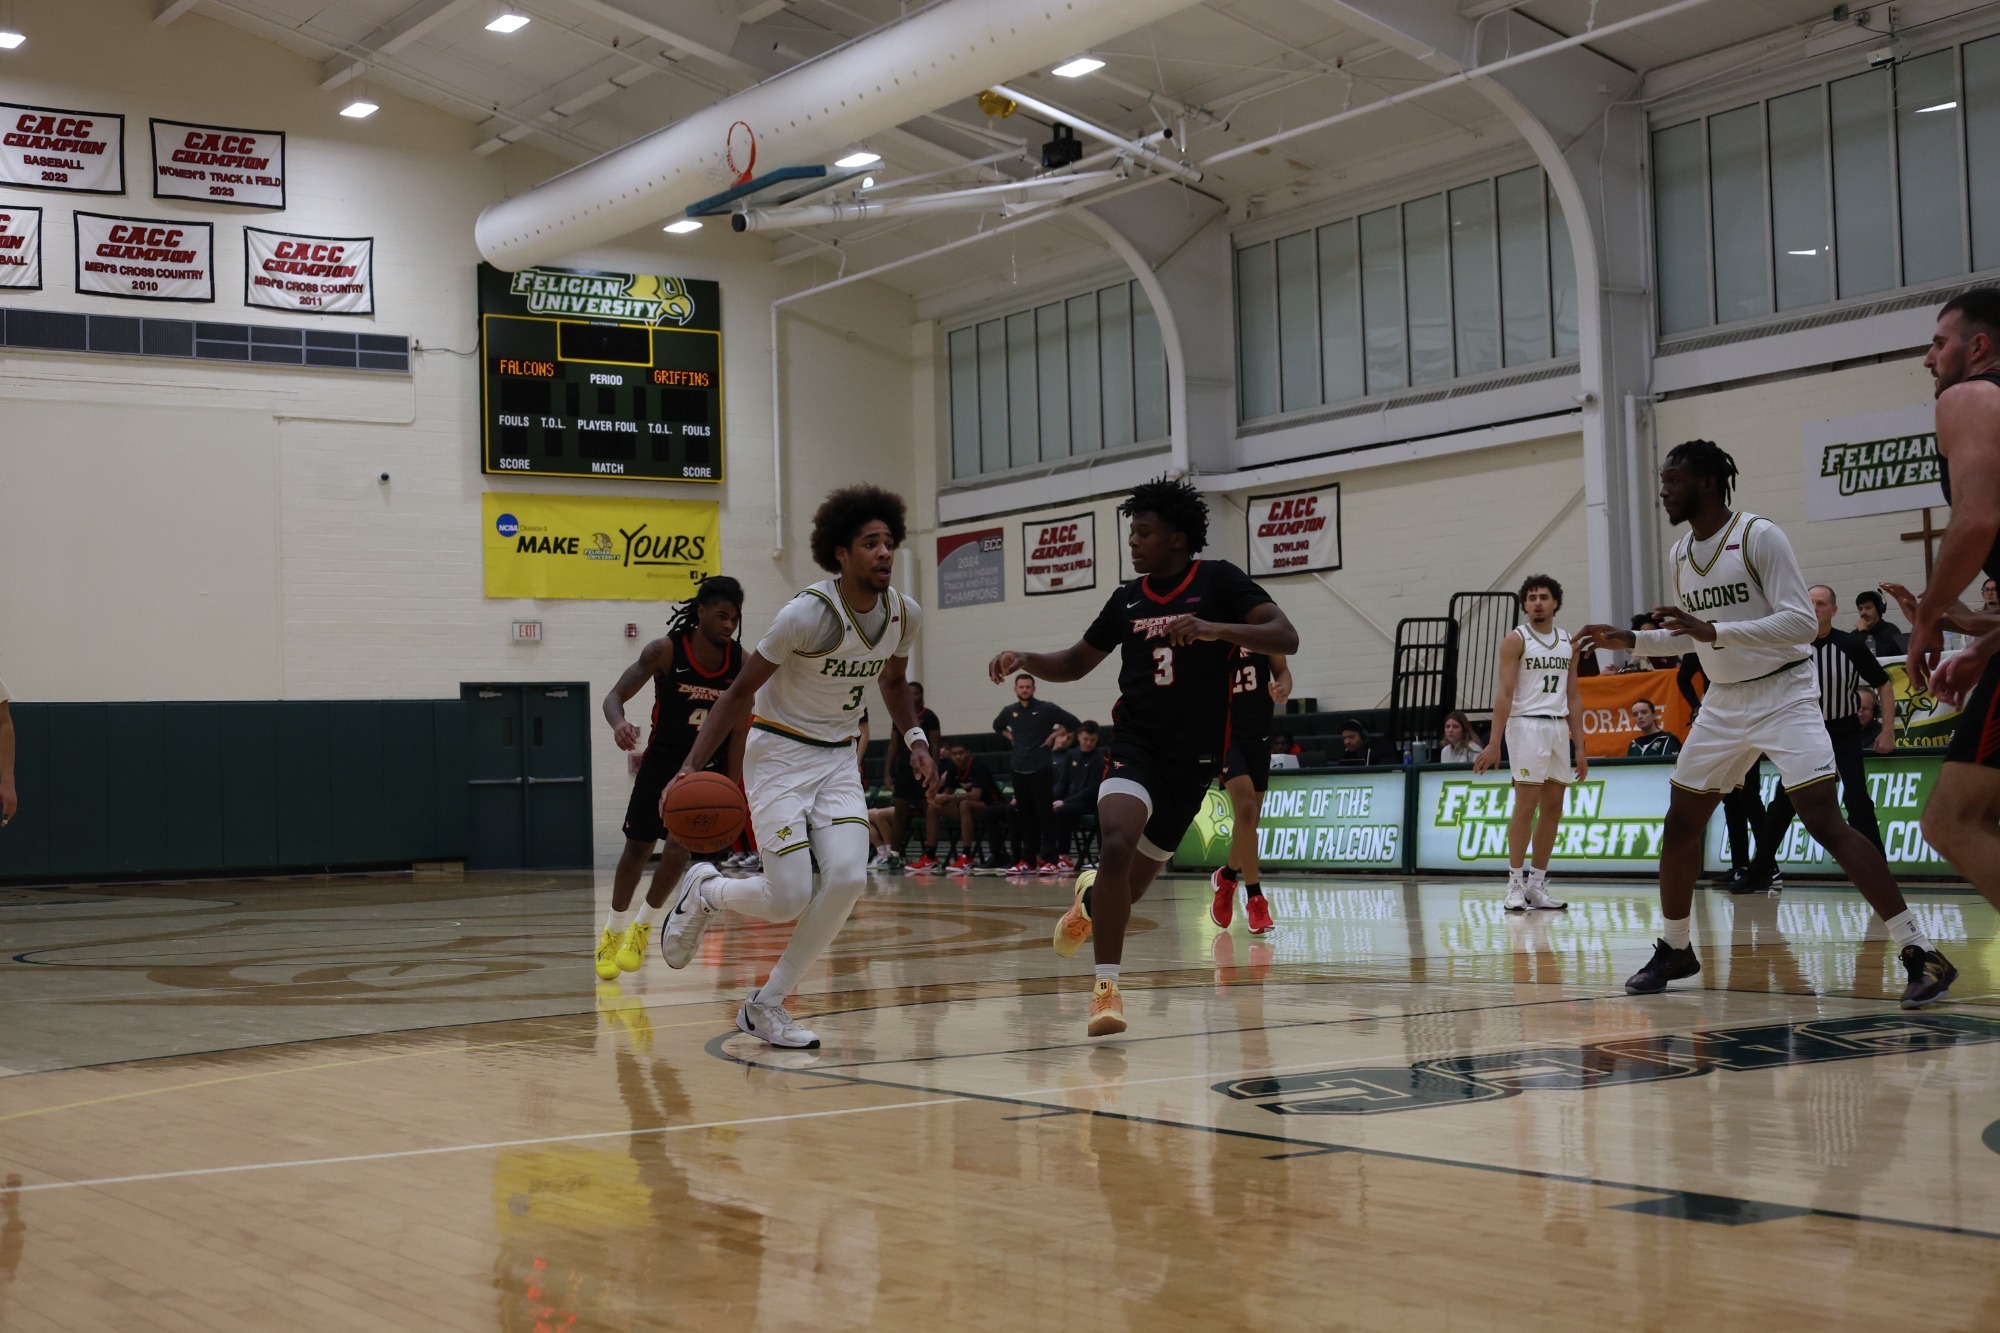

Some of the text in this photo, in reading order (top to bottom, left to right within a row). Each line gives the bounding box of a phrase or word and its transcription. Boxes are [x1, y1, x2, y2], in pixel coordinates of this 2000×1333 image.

[16, 114, 93, 138] CACC
[3, 133, 107, 154] CHAMPION
[184, 131, 256, 155] CACC
[24, 155, 84, 170] BASEBALL
[172, 149, 269, 170] CHAMPION
[41, 171, 68, 183] 2023
[159, 166, 281, 187] WOMEN'S TRACK & FIELD
[209, 186, 234, 197] 2023
[108, 225, 183, 248] CACC
[96, 244, 197, 263] CHAMPION
[275, 241, 344, 263] CACC
[85, 261, 204, 280] MEN'S CROSS COUNTRY
[262, 258, 357, 277] CHAMPION
[132, 281, 158, 291] 2010
[254, 276, 364, 293] MEN'S CROSS COUNTRY
[515, 271, 620, 297] FELICIAN
[299, 296, 322, 305] 2011
[531, 292, 659, 319] UNIVERSITY
[500, 359, 554, 377] FALCONS
[590, 373, 623, 386] PERIOD
[654, 369, 709, 387] GRIFFINS
[499, 415, 530, 427] FOULS
[541, 417, 566, 429] T.O.L.
[577, 419, 638, 433] PLAYER FOUL
[648, 423, 673, 434] T.O.L.
[682, 425, 711, 436] FOULS
[500, 458, 530, 470] SCORE
[1825, 436, 1937, 473] FELICIAN
[592, 463, 624, 474] MATCH
[683, 467, 711, 478] SCORE
[1842, 461, 1941, 494] UNIVERS
[1268, 496, 1318, 521] CACC
[1038, 524, 1078, 546] CACC
[1257, 516, 1326, 537] CHAMPION
[516, 536, 580, 554] MAKE
[619, 523, 705, 568] YOURS
[983, 538, 1002, 551] ECC
[1031, 541, 1084, 560] CHAMPION
[1273, 539, 1309, 553] BOWLING
[958, 556, 979, 569] 2024
[975, 566, 999, 576] INDOOR
[1075, 558, 1092, 570] FIELD
[943, 576, 999, 591] TRACK AND FIELD
[944, 587, 999, 604] CHAMPIONS
[519, 624, 536, 638] EXIT
[820, 658, 886, 677] FALCO
[1152, 646, 1174, 686] 3
[1542, 675, 1559, 693] 17
[843, 685, 864, 711] 3
[688, 708, 709, 732] 4
[1582, 705, 1665, 734] ORAE
[1867, 772, 1921, 807] THE
[1260, 787, 1373, 818] HOME OF THE
[1312, 825, 1398, 862] FALCONS
[1460, 822, 1666, 857] UNERSITY
